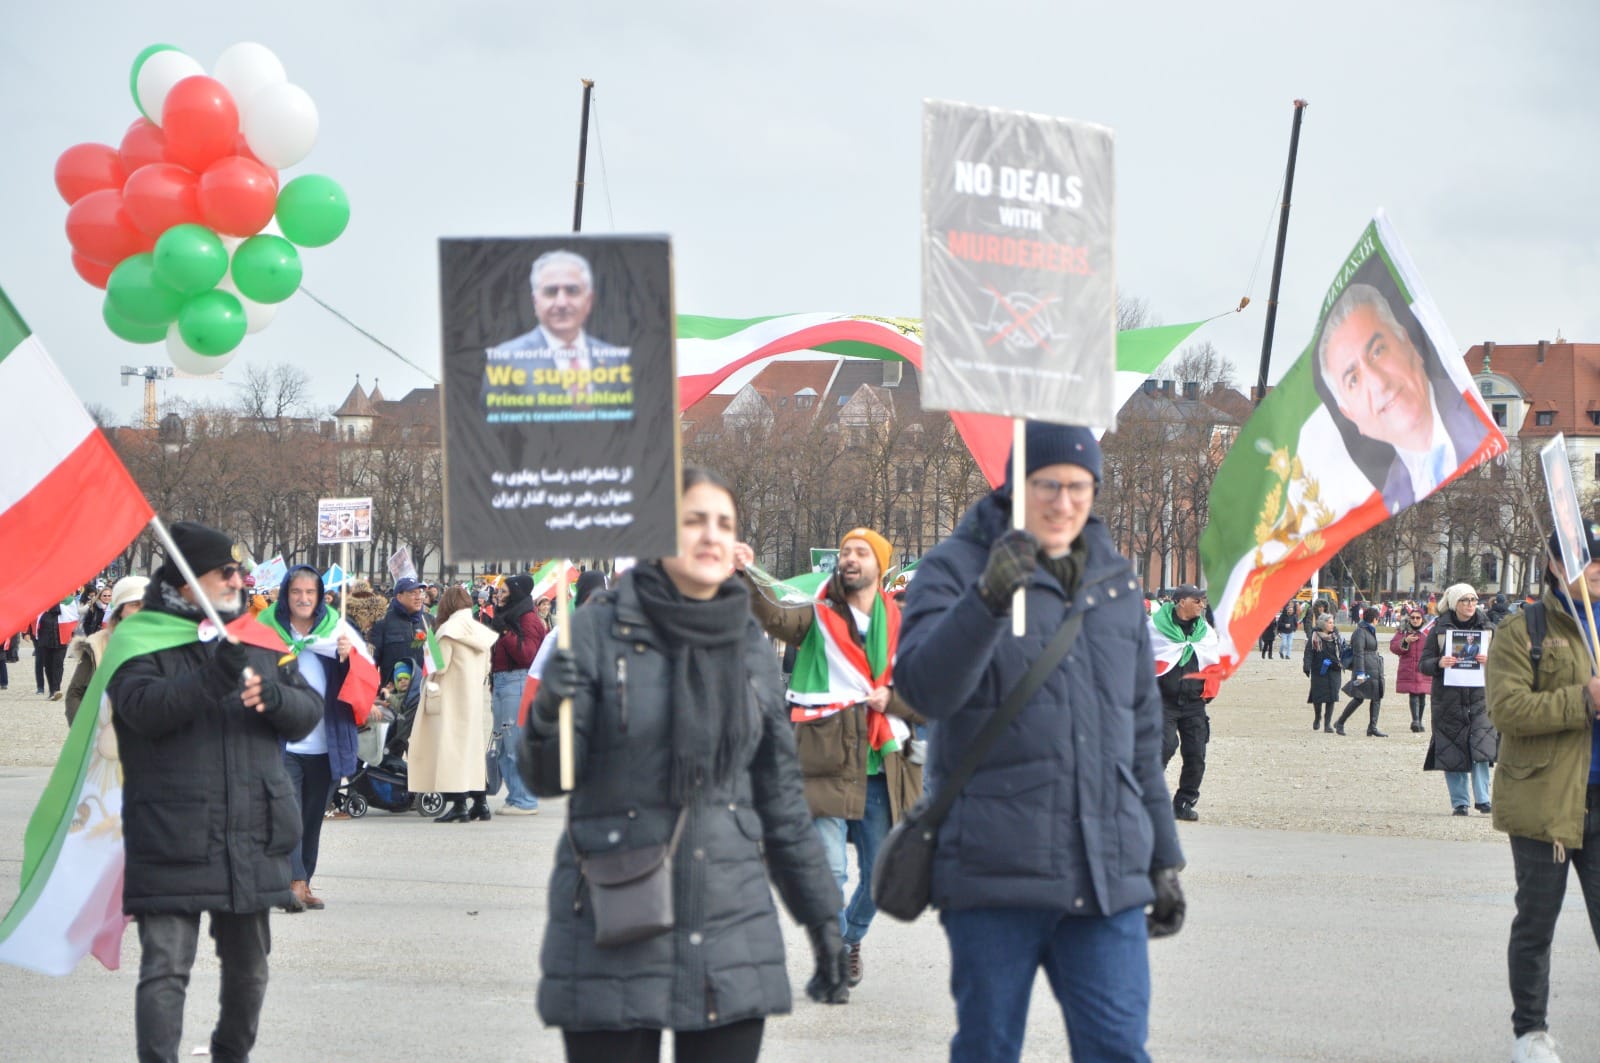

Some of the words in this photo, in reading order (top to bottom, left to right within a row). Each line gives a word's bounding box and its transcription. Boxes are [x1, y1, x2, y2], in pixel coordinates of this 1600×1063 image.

[954, 159, 993, 197] NO
[1000, 165, 1084, 209] DEALS
[998, 205, 1043, 231] WITH
[485, 347, 511, 360] The
[512, 348, 552, 360] world
[591, 346, 631, 359] know
[485, 364, 527, 387] We
[532, 363, 632, 390] support
[486, 391, 535, 408] Prince
[537, 391, 574, 406] Reza
[575, 388, 633, 405] Pahlavi
[486, 412, 500, 423] as
[532, 409, 596, 422] transitional
[597, 408, 634, 421] leader
[491, 470, 504, 485] به
[506, 469, 539, 486] پهلوی
[541, 468, 569, 485] رضا
[571, 467, 619, 484] شاهزاده
[621, 466, 632, 484] از
[492, 491, 520, 508] ایران
[547, 492, 572, 507] دوره
[574, 491, 598, 507] رهبر
[600, 489, 631, 506] عنوان
[593, 512, 632, 527] حمایت
